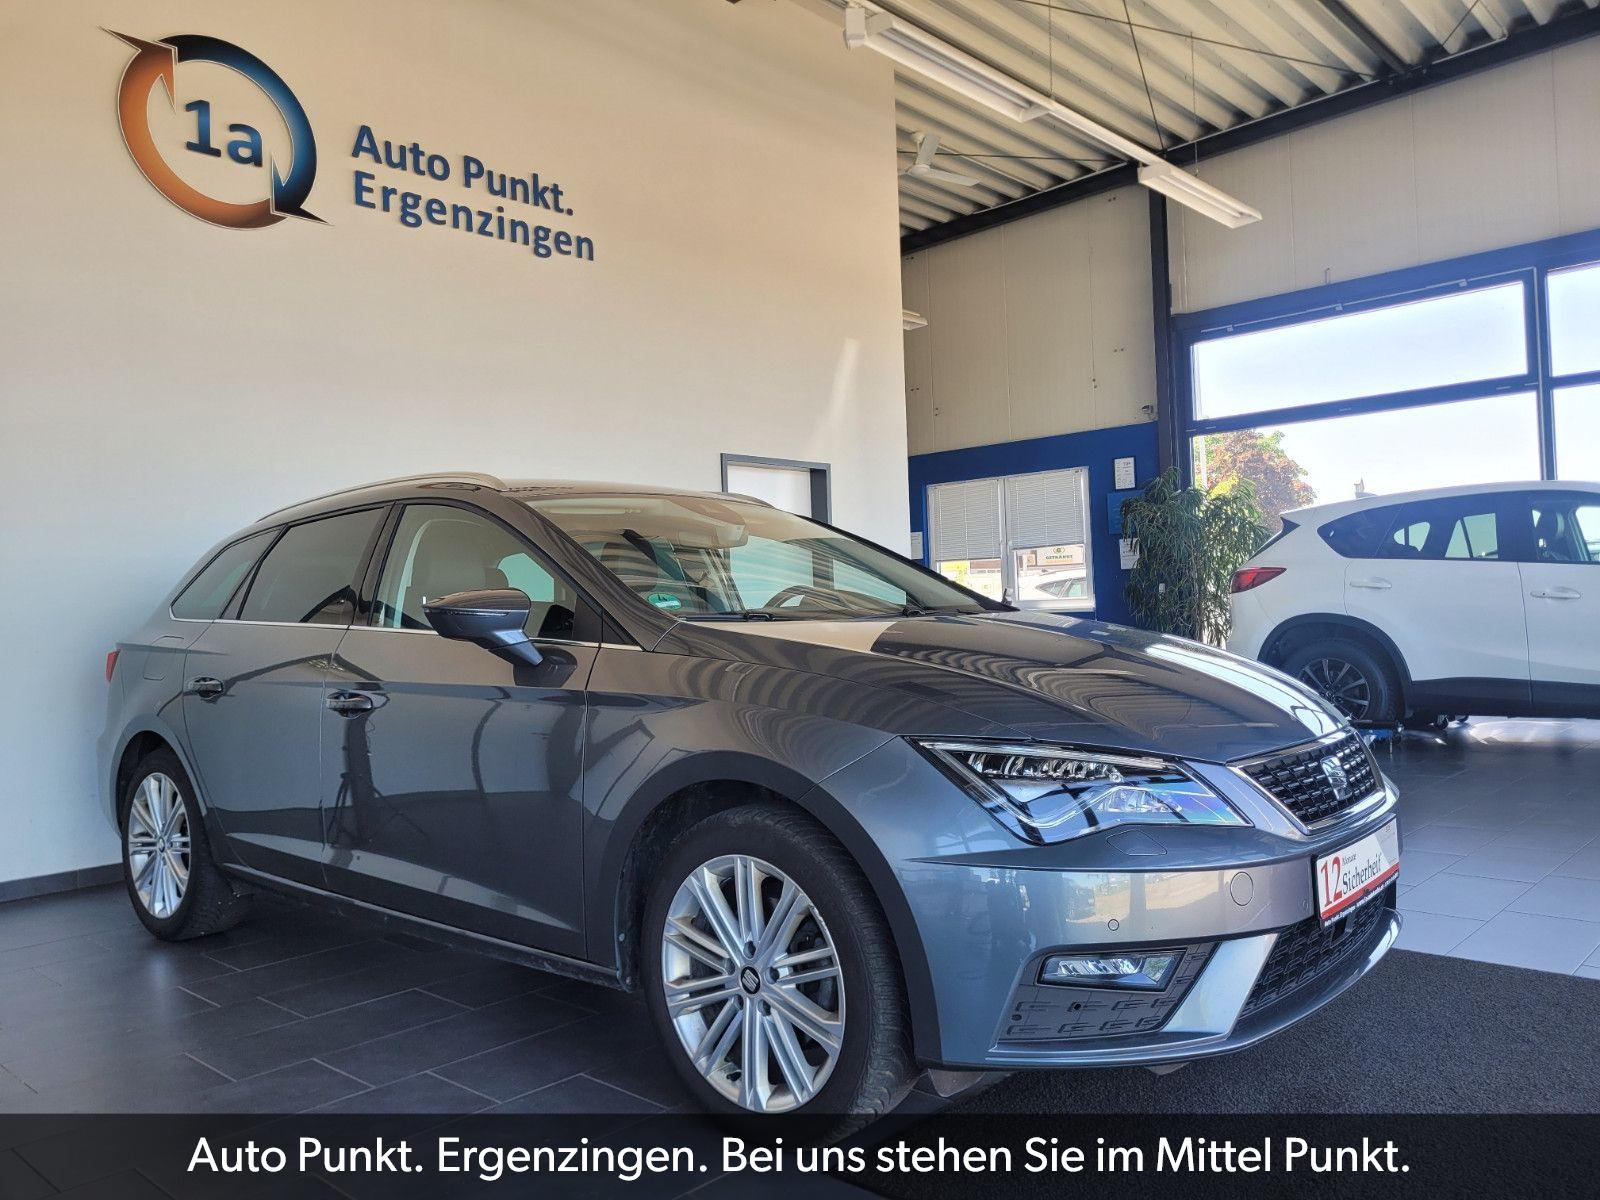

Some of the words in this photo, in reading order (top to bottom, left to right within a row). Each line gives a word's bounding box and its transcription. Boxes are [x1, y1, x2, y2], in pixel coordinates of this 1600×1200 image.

[184, 99, 263, 168] 1a
[351, 124, 451, 182] Auto
[462, 154, 574, 217] Punkt.
[353, 169, 595, 262] Ergenzingen
[1321, 856, 1343, 907] 12
[1343, 853, 1382, 895] Sicherheit
